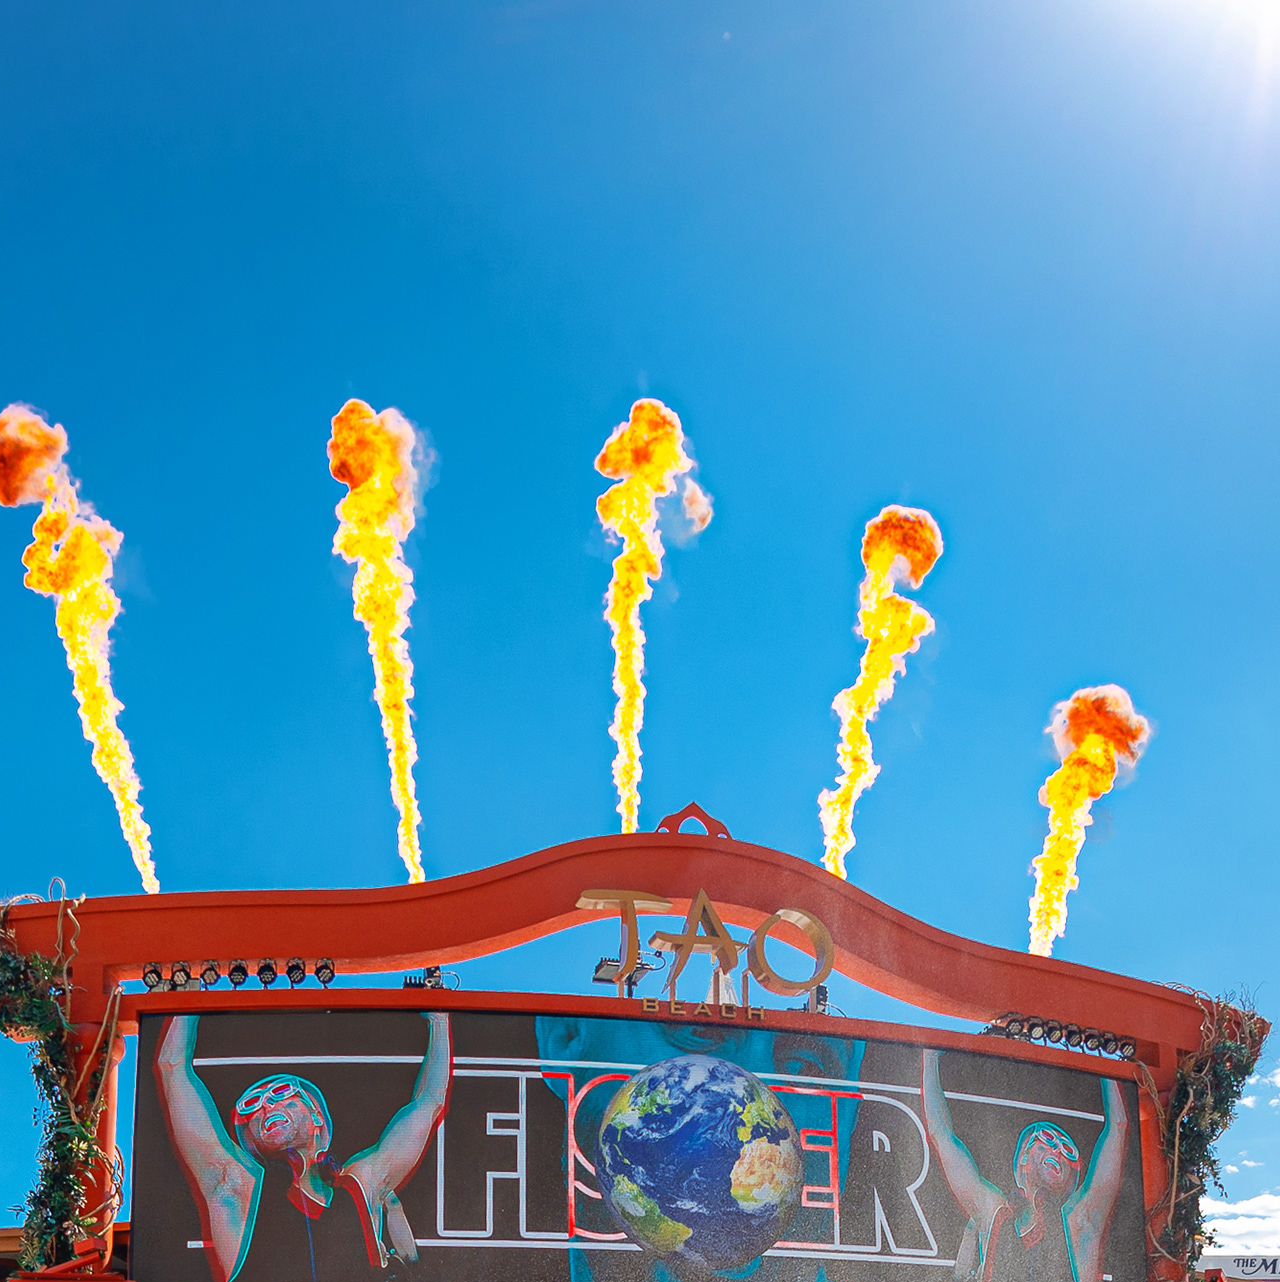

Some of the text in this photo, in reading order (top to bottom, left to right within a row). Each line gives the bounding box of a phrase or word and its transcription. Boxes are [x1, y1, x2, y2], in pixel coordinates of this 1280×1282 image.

[575, 887, 835, 997] TAO
[641, 997, 766, 1021] BEACH
[436, 1070, 939, 1256] FIER
[1233, 1258, 1257, 1268] THE
